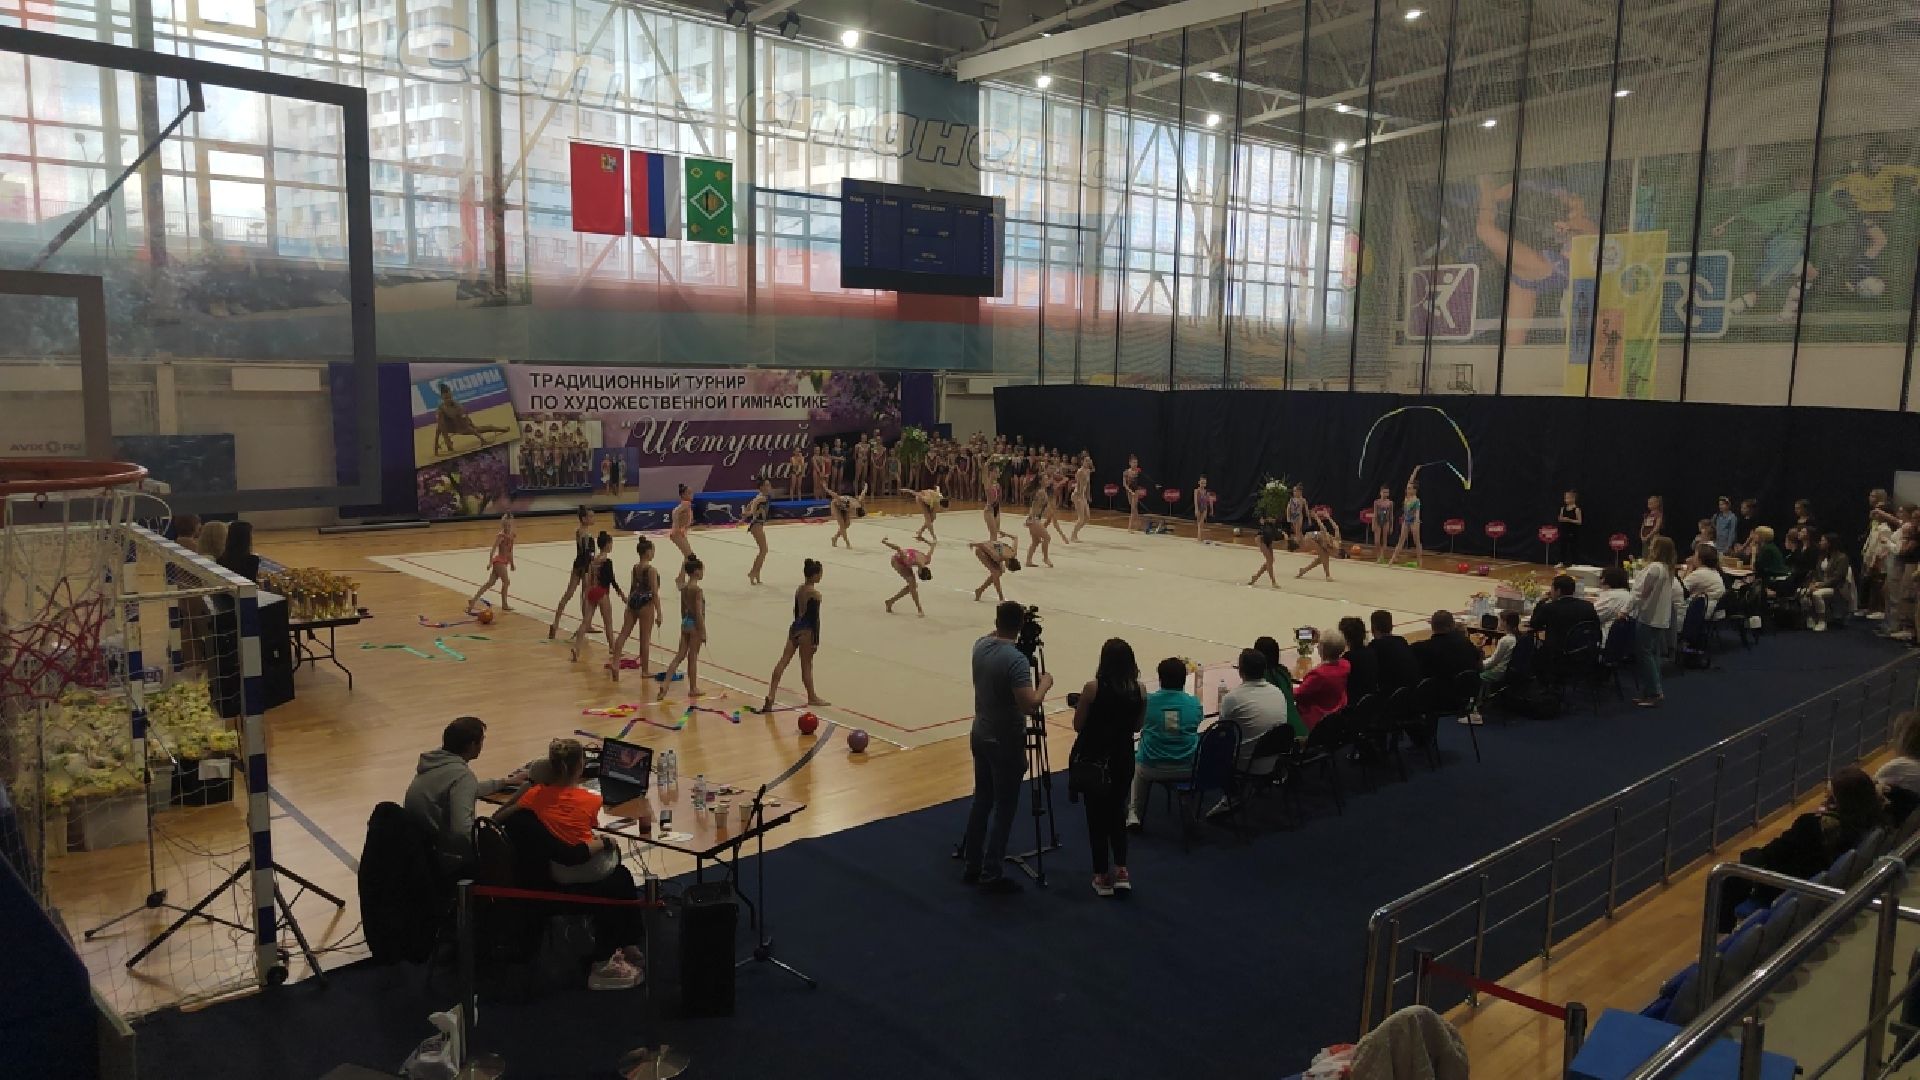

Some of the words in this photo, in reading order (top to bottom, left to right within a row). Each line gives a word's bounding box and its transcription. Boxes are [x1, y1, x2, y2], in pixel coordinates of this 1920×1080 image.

[529, 372, 681, 391] ТРАДИЦИОННЫЙ
[684, 375, 746, 390] ТУРНИР
[530, 395, 559, 410] ПО
[564, 393, 728, 412] ХУДОЖЕСТВЕННОЙ
[732, 396, 829, 410] ГИМНАСТИКЕ
[662, 513, 671, 523] 2
